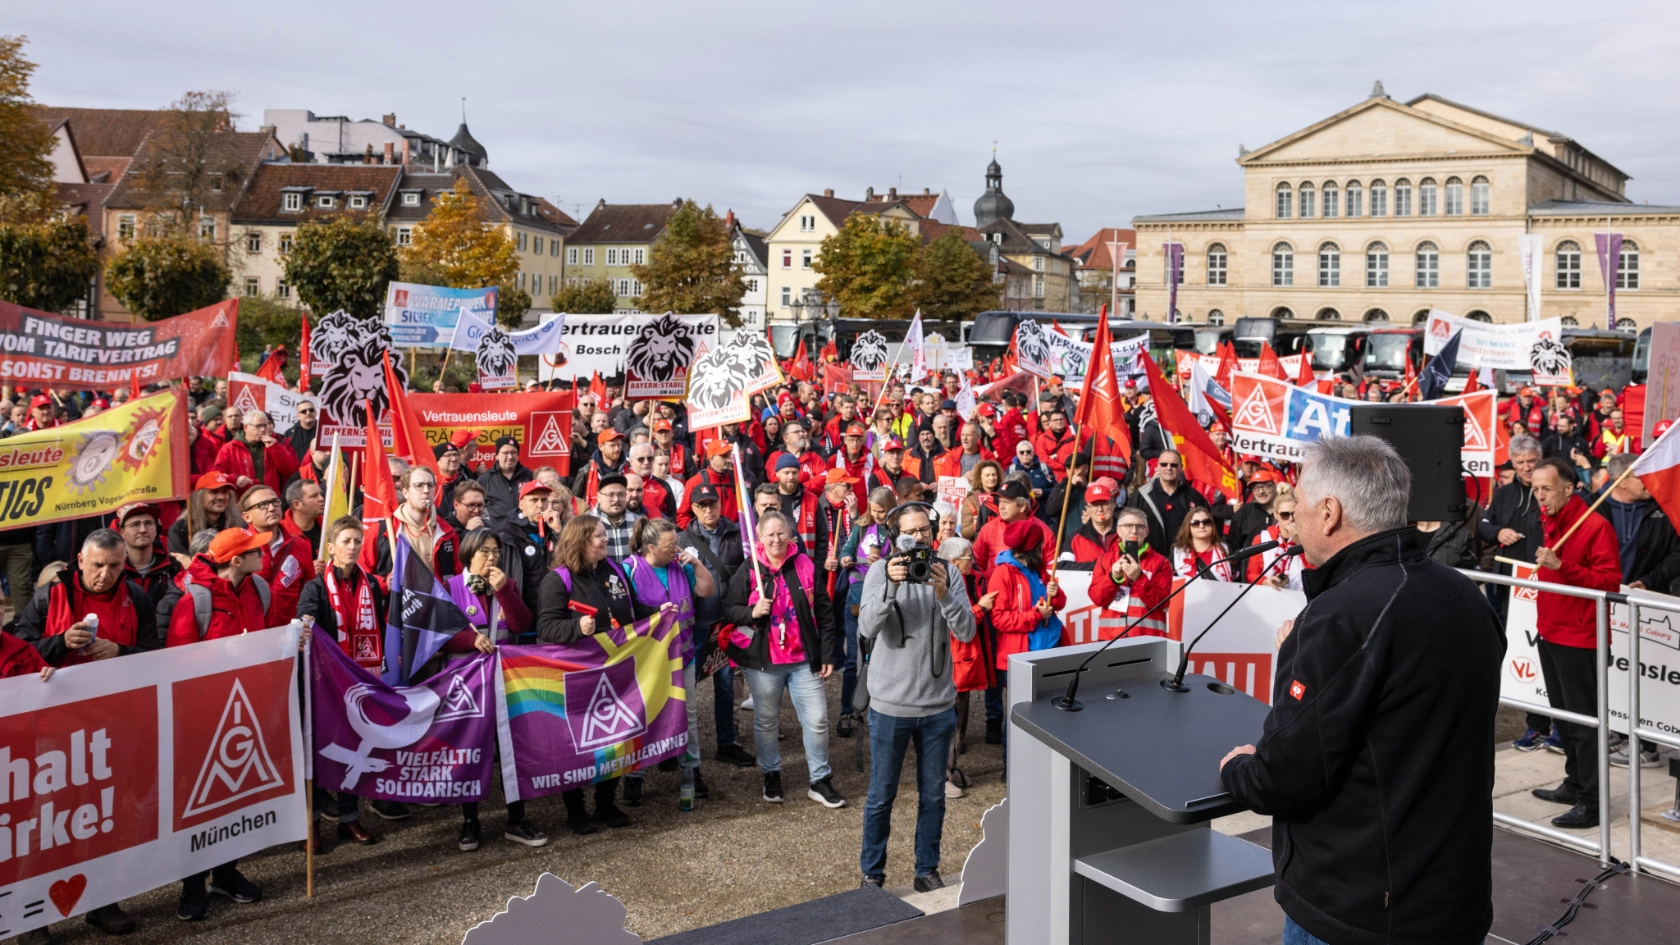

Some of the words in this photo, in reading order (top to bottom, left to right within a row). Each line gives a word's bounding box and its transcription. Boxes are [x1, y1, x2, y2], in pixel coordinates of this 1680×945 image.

[25, 316, 102, 346] FINGER
[106, 331, 152, 347] WEG
[43, 340, 178, 364] TARIFVERTRAG
[575, 344, 620, 355] Bosch
[1, 359, 65, 379] SONST
[422, 410, 518, 423] Vertrauensleute
[693, 405, 744, 420] BAYERN:STABIL
[324, 427, 393, 438] BAYERN:SBIL
[55, 498, 97, 512] Nürnberg
[1645, 628, 1672, 641] Coburg
[396, 746, 482, 767] VIELFÄLTIG
[398, 765, 454, 781] STARK
[531, 772, 561, 791] WIR
[563, 765, 597, 785] SIND
[375, 777, 482, 798] SOLIDARISCH
[190, 809, 277, 853] München
